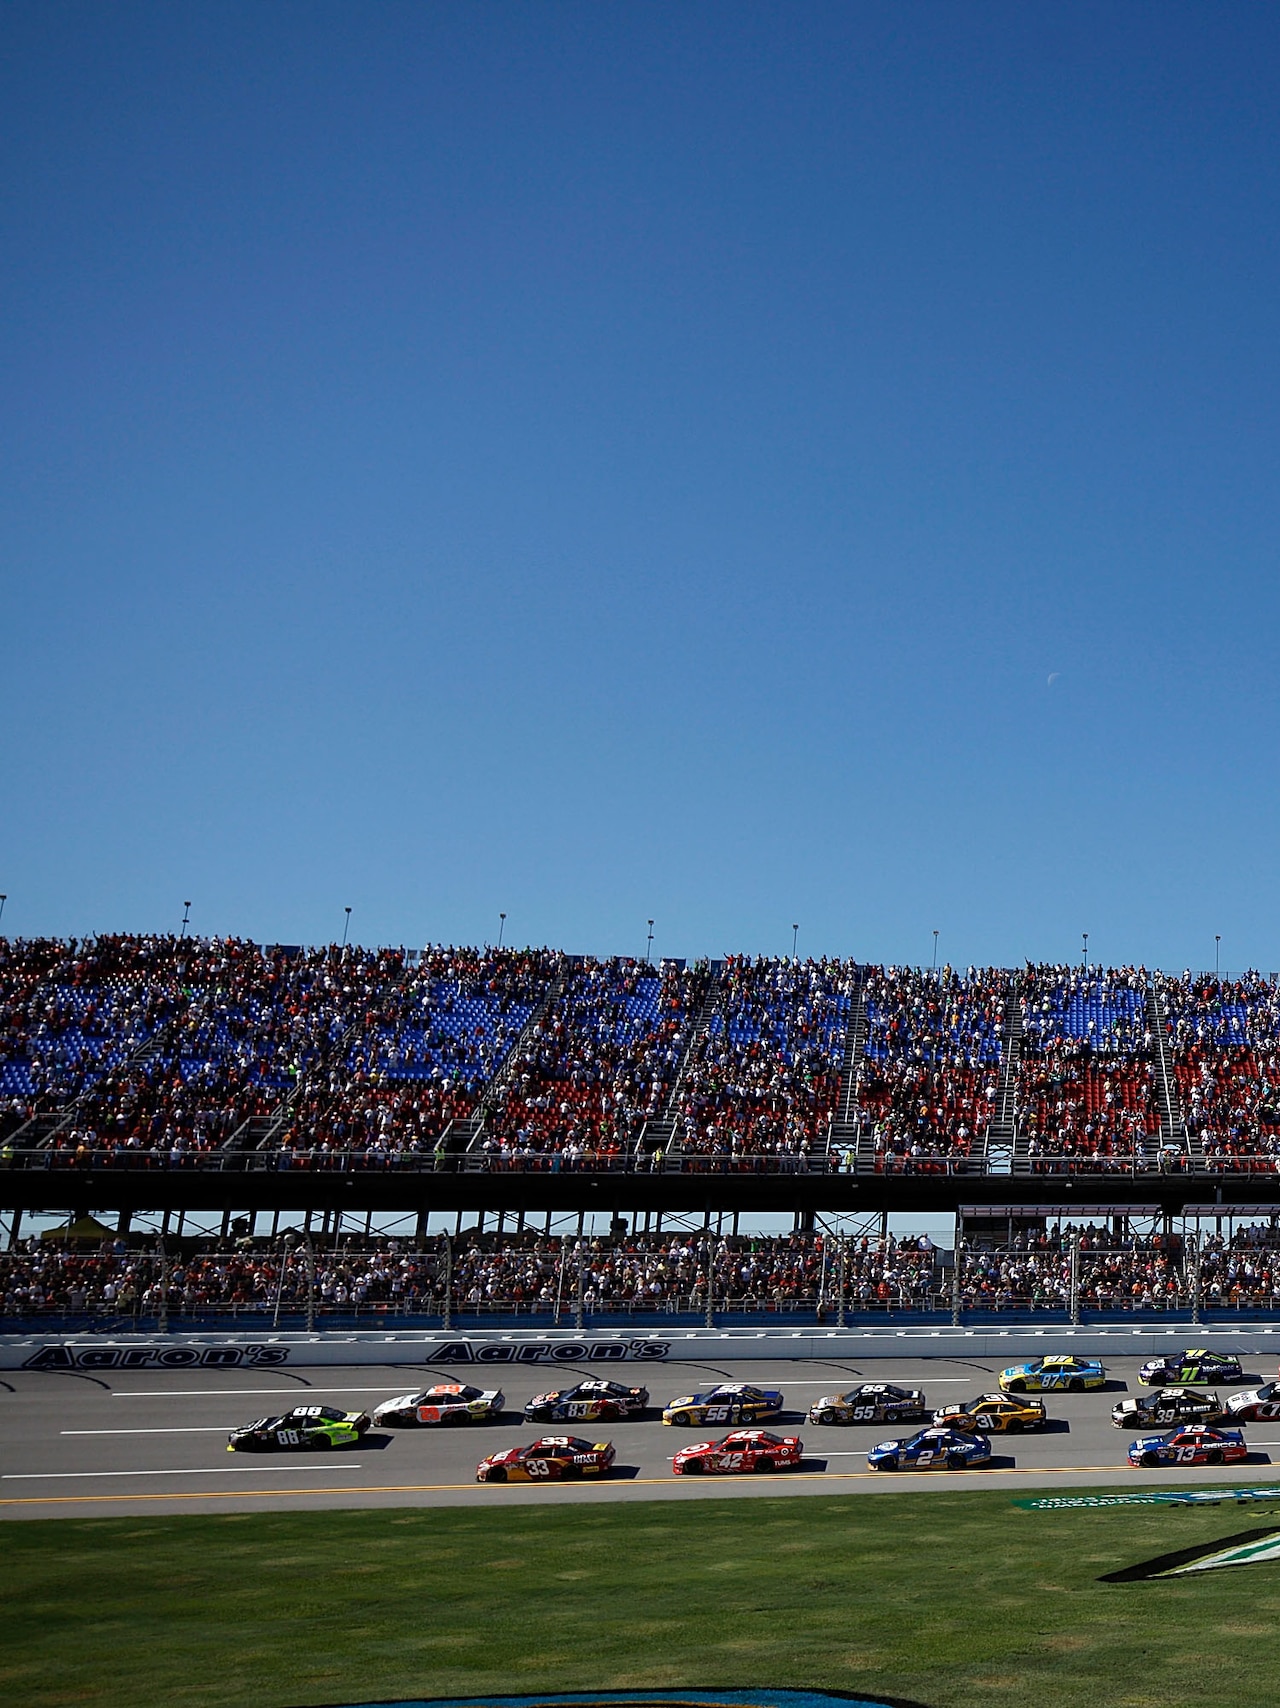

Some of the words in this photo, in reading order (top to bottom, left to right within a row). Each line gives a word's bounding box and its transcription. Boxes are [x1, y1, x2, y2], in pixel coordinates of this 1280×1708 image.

[23, 1345, 290, 1368] Aaron's
[426, 1340, 671, 1362] Aaron's
[1180, 1367, 1199, 1381] 71
[580, 1381, 610, 1390] 83
[1041, 1375, 1059, 1388] 87
[861, 1385, 887, 1393] 55
[1161, 1389, 1184, 1397] 39
[983, 1394, 1008, 1402] 31
[293, 1406, 322, 1416] 88
[567, 1404, 587, 1417] 83
[705, 1408, 729, 1421] 56
[853, 1406, 875, 1420] 55
[1155, 1409, 1175, 1423] 39
[976, 1414, 994, 1428] 31
[277, 1430, 299, 1445] 88
[541, 1437, 568, 1445] 33
[728, 1431, 764, 1439] 42
[719, 1453, 743, 1468] 42
[916, 1450, 934, 1465] 2
[1176, 1447, 1196, 1461] 13
[526, 1460, 550, 1476] 33
